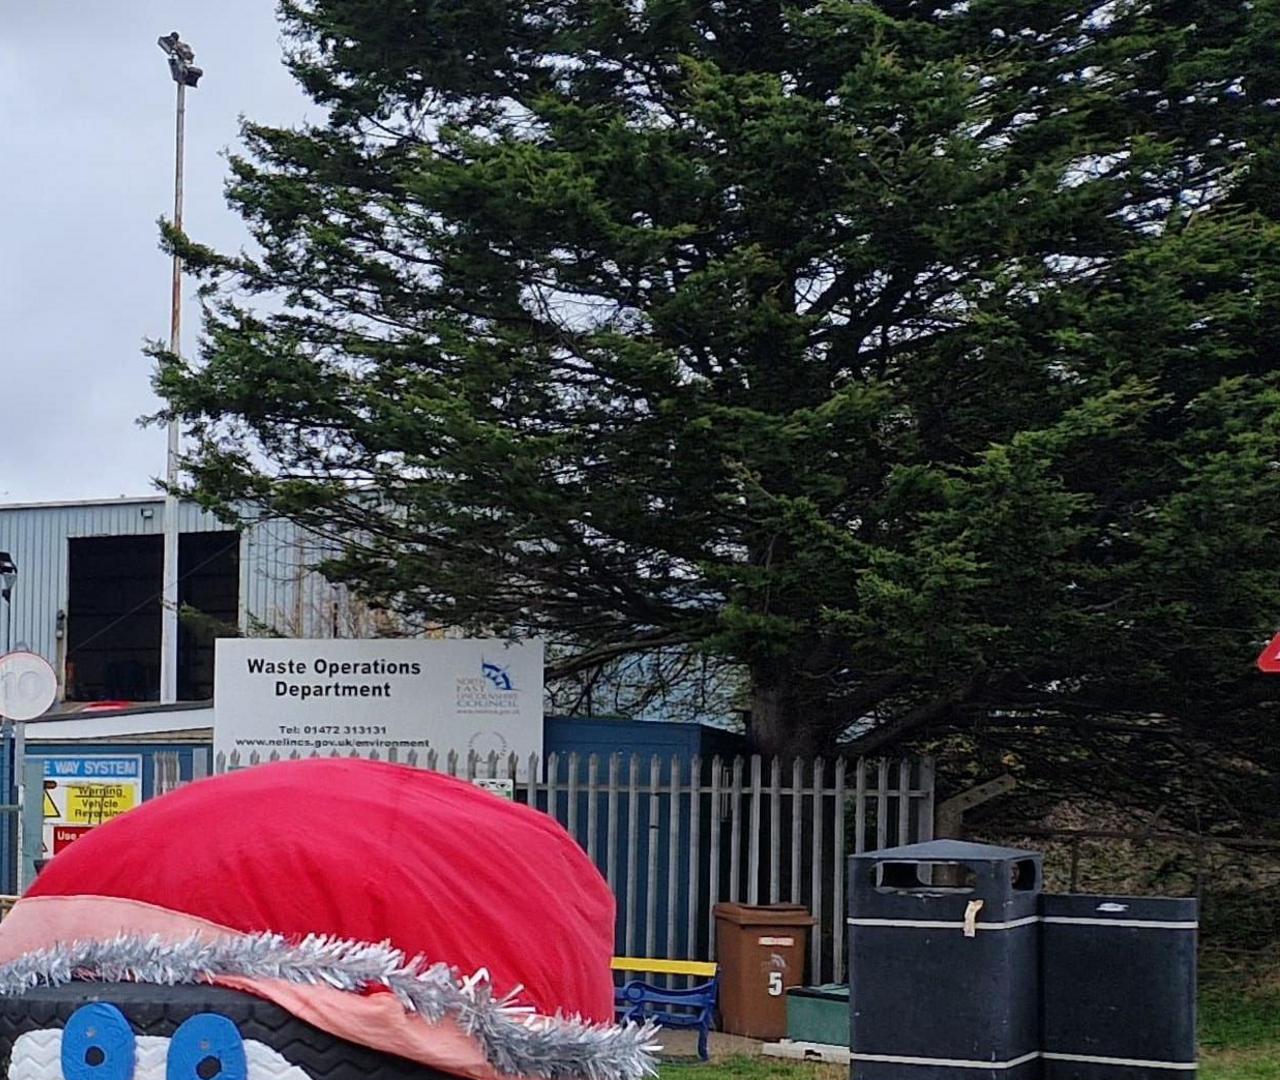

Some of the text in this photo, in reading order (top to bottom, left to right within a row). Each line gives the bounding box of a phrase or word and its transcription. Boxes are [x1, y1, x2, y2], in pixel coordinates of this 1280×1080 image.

[247, 658, 422, 678] Waste Operations
[274, 680, 391, 701] Department
[279, 725, 387, 735] Tel: 01472 313131
[235, 737, 430, 749] www.nelincs.gov.uk/environment
[54, 760, 80, 775] WAY
[84, 760, 137, 775] SYSTEM
[81, 799, 119, 809] Vehicle
[56, 831, 78, 841] Use
[768, 971, 783, 996] 5
